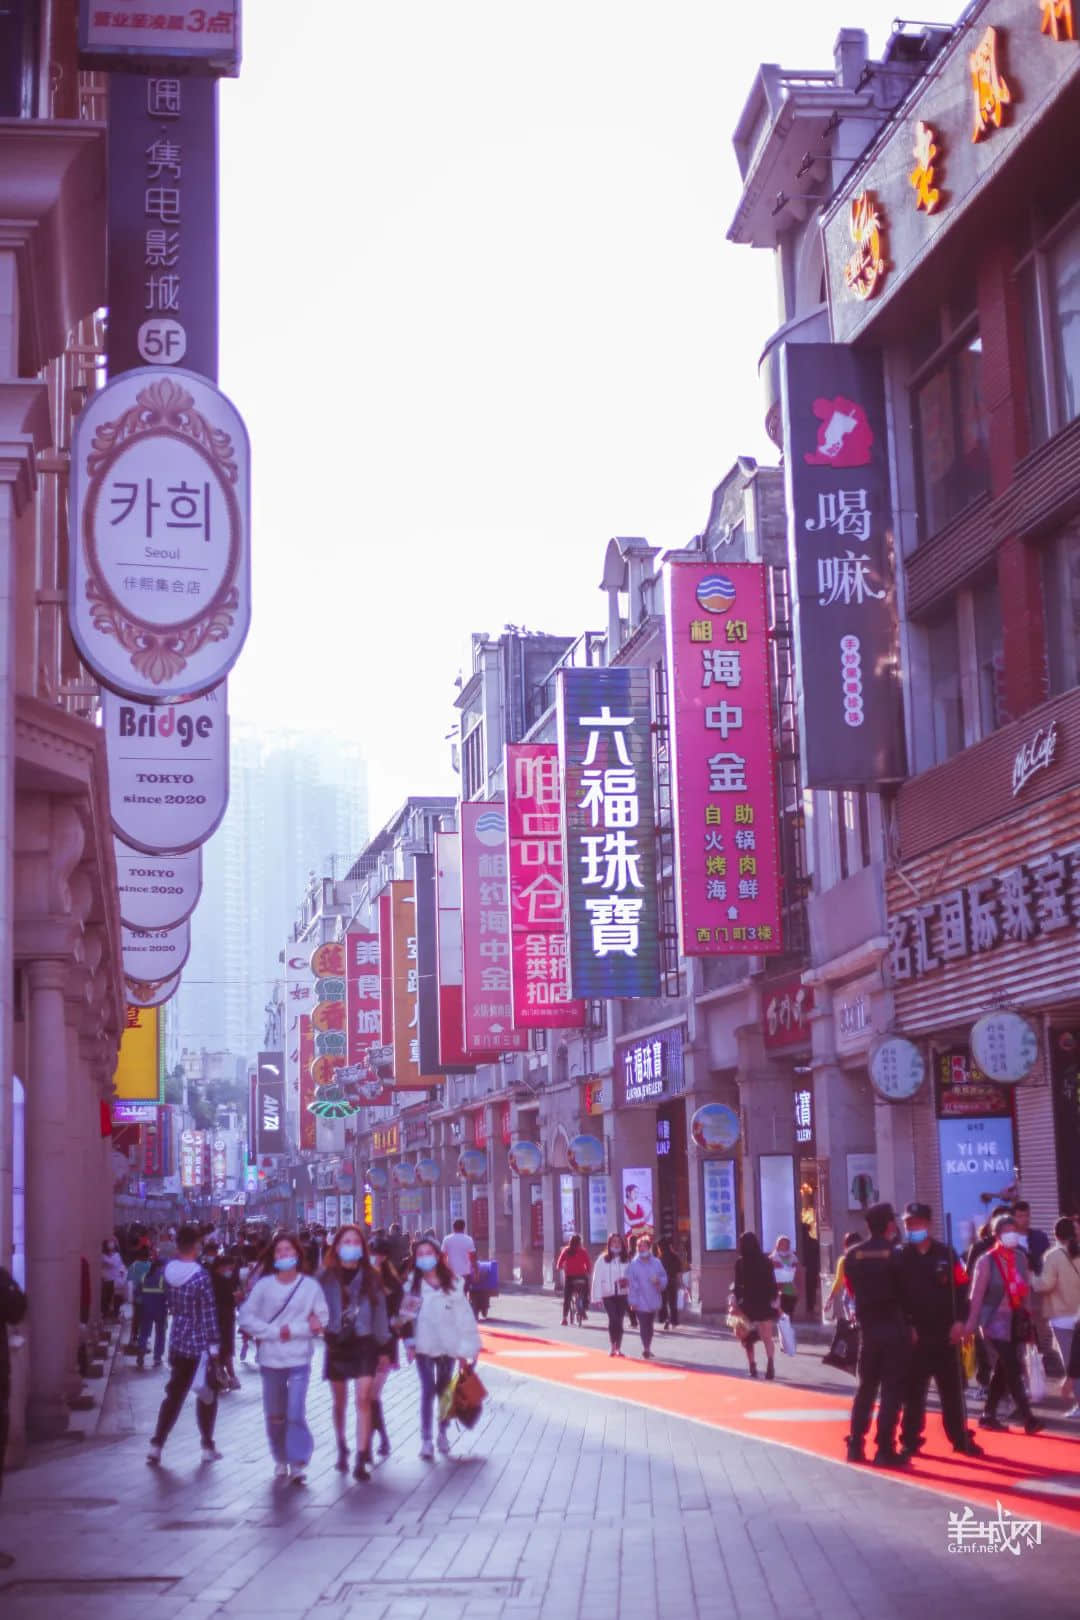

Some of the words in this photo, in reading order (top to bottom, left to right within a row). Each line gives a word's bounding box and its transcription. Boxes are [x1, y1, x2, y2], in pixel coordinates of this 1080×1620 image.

[144, 329, 182, 357] 5F
[110, 477, 210, 542] 카희
[144, 546, 180, 560] Seoul
[805, 488, 887, 607] 喝嘛
[690, 619, 749, 641] 相约
[118, 704, 214, 747] Bridge
[702, 649, 748, 792] 海中金
[136, 773, 194, 784] TOKYO
[123, 793, 162, 804] since
[164, 794, 207, 805] 2020
[705, 804, 754, 825] 自助
[515, 754, 565, 924] 唯品仓
[578, 706, 645, 958] 六福珠寶
[705, 830, 756, 851] 火锅
[128, 868, 175, 878] TOKYO
[706, 856, 757, 876] 烤肉
[118, 885, 149, 894] since
[151, 886, 184, 895] 2020
[706, 879, 758, 901] 海鲜
[887, 853, 1080, 980] 名汇国际珠宝
[696, 925, 773, 943] 西门町3楼
[149, 944, 176, 952] 2020
[263, 1093, 280, 1131] ANTA
[945, 1158, 979, 1175] KAO
